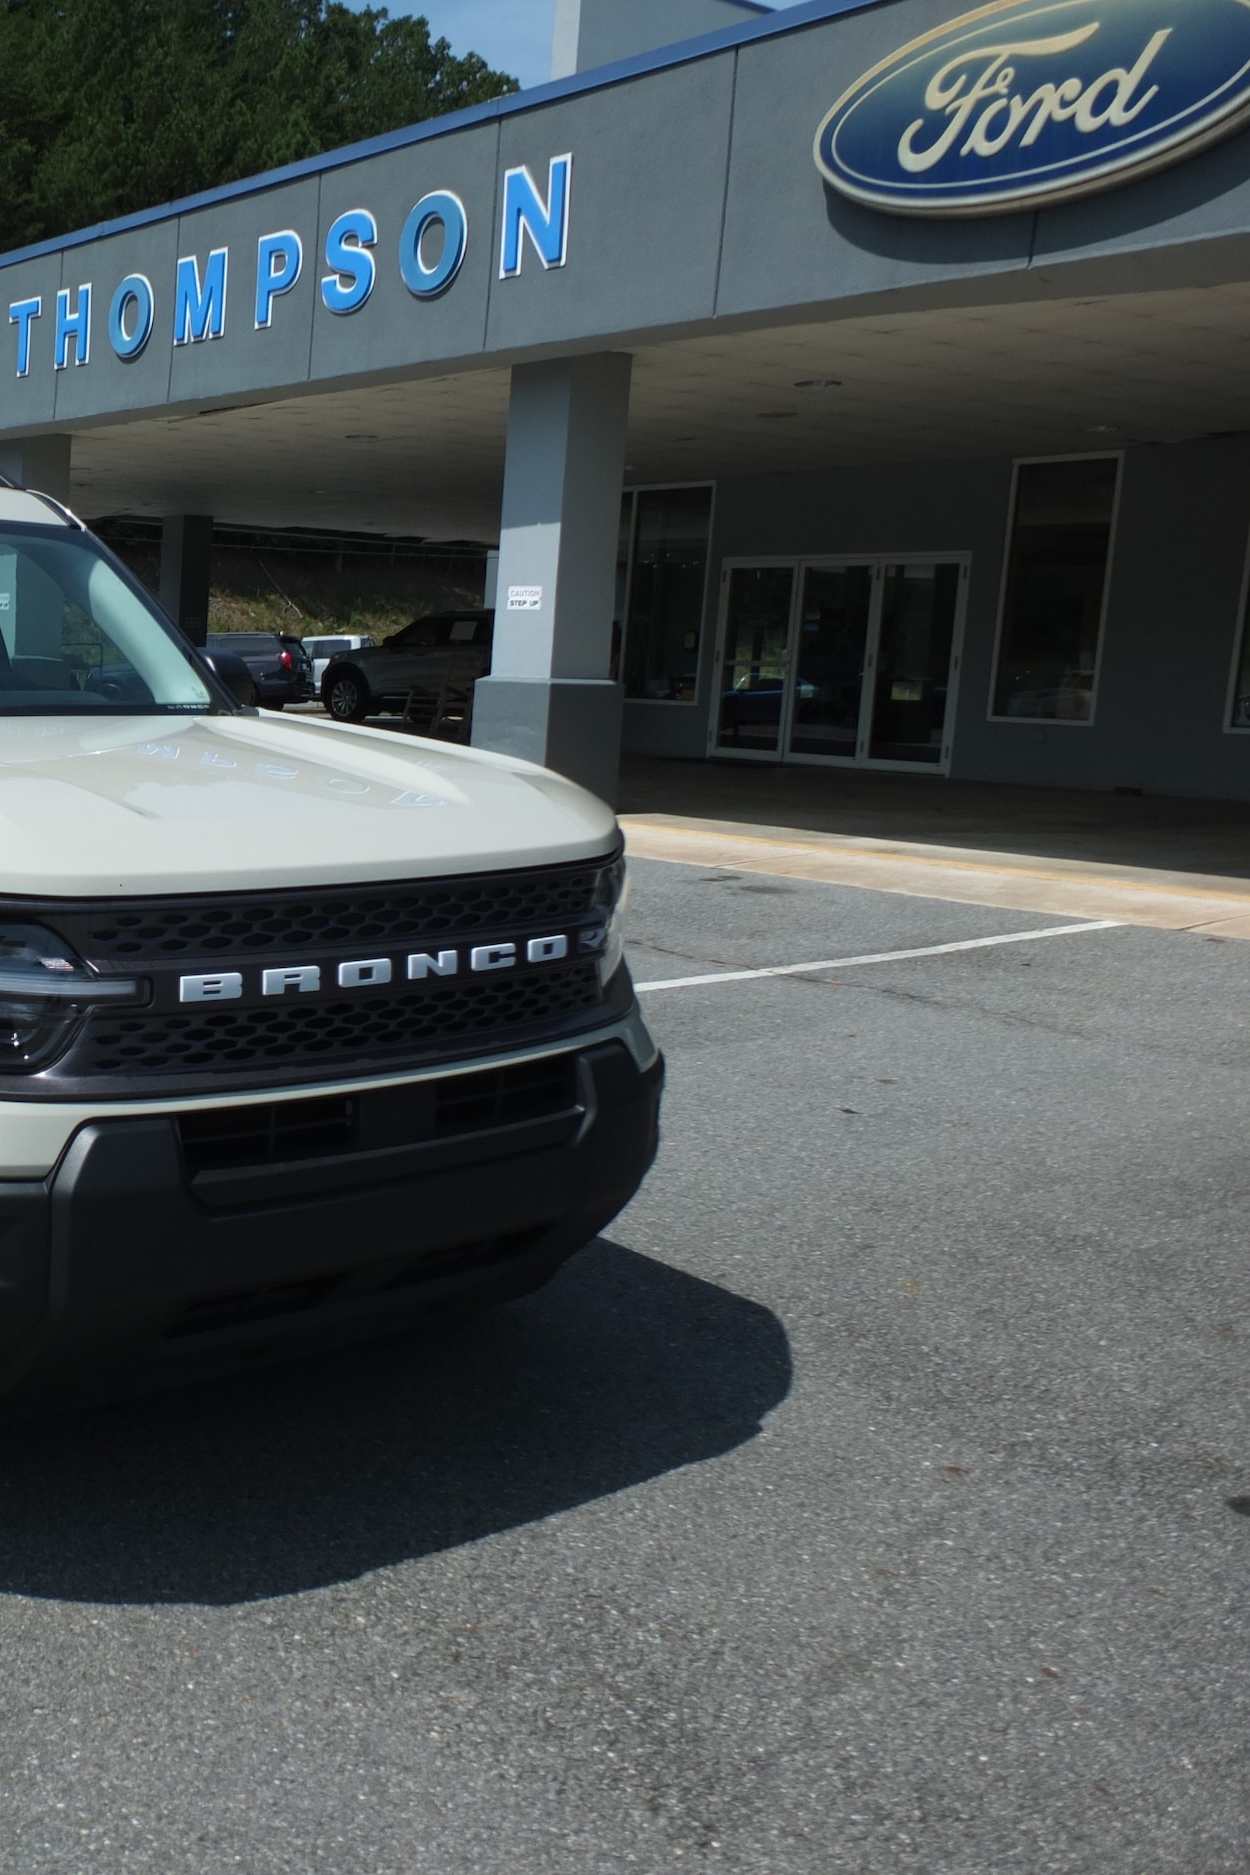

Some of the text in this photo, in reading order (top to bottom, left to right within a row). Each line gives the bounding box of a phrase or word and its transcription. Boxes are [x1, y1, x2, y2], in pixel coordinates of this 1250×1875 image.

[897, 21, 1174, 173] Ford
[8, 151, 574, 376] THOMPSON
[179, 933, 568, 1003] BRONCO
